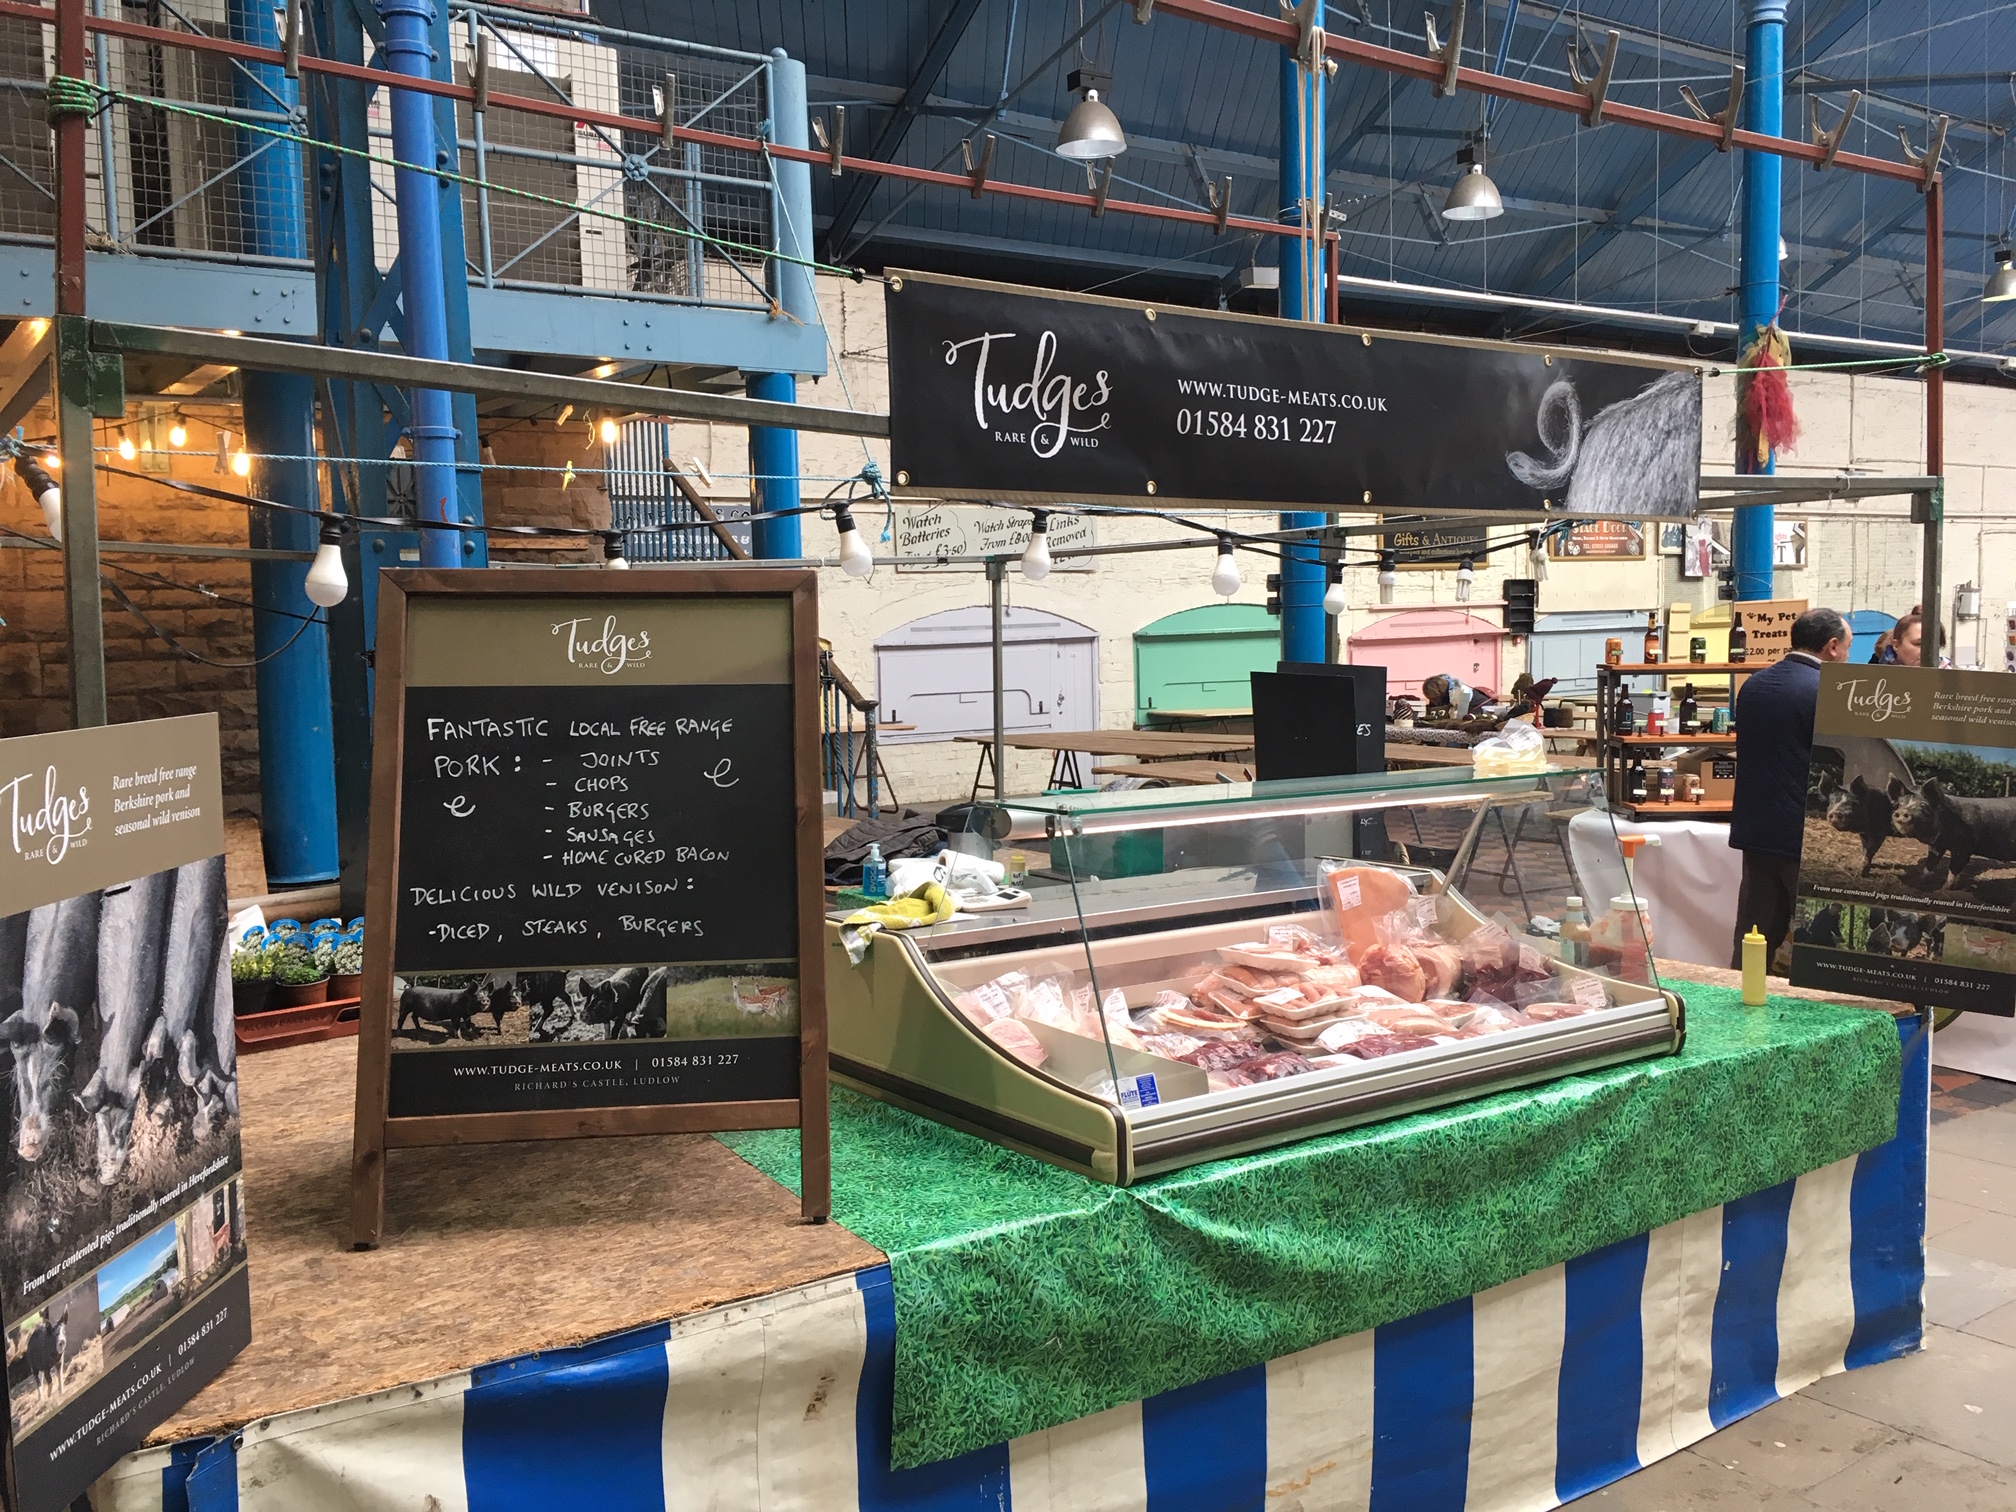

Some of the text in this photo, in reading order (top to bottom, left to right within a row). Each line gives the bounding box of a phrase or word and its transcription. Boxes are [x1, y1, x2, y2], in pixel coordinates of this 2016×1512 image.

[941, 330, 1114, 459] Tudges
[1177, 377, 1388, 413] WWW.TUDGE-MEATS.CO.UK
[1176, 407, 1338, 444] 01584 831 227
[994, 430, 1099, 449] RARE & WILD
[902, 513, 942, 530] Watch
[973, 519, 1004, 534] Watch
[1049, 515, 1080, 532] Links
[899, 527, 951, 547] Batteries
[979, 537, 1007, 551] From
[1393, 532, 1419, 547] Gifts
[1421, 535, 1430, 545] &
[1757, 612, 1797, 626] My Pet
[551, 615, 653, 675] Tudges
[1752, 629, 1788, 639] Treats
[1767, 647, 1781, 657] per
[626, 661, 646, 669] WILD
[1836, 678, 1912, 722] Tudges
[1932, 702, 2012, 715] Berkshire pork and
[1933, 691, 2016, 706] Rare breed free rang
[427, 716, 733, 741] FANTASTIC LOCAL FREE RANGE
[1930, 714, 2016, 726] seasonal wild veniso
[580, 749, 660, 769] JOINTS
[112, 764, 197, 790] Rare breed free range
[574, 775, 629, 792] CHOPS
[113, 784, 190, 813] Berkshire pork and
[0, 765, 93, 865] Tudges
[114, 805, 200, 836] seasonal wild venison
[567, 801, 650, 824] BURGERS
[566, 827, 656, 848] SAUSAGES
[24, 838, 88, 861] RARE & WILD
[562, 849, 609, 866] HOME
[614, 849, 666, 866] CURED
[675, 846, 730, 862] BACON
[410, 883, 517, 906] DELICIOUS
[532, 883, 582, 898] WILD
[1813, 884, 1831, 892] From
[1843, 889, 1876, 897] contented
[1875, 892, 1889, 900] pigs
[1890, 894, 1933, 906] traditionally
[1933, 899, 1955, 907] reared
[1964, 902, 2011, 914] Herefordshire
[618, 914, 704, 938] BURGERS
[1816, 961, 1917, 981] WWW.TUDGE-MEATS.CO.UK
[1934, 977, 1958, 987] 01584
[1959, 980, 1974, 989] 831
[1975, 983, 1991, 991] 227
[453, 1060, 622, 1077] WWW.TUDGE-MEATS.CO.UK
[651, 1057, 688, 1068] 01584
[692, 1055, 713, 1066] 831
[717, 1054, 739, 1065] 227
[514, 1079, 578, 1091] RICHARD'S
[633, 1075, 681, 1086] LUDLOW
[23, 1155, 229, 1296] From our contented pigs traditionally reared in Herefordshire
[49, 1362, 162, 1462] WWW.TUDGE-MEATS.CO.UK
[178, 1331, 200, 1356] 01584
[201, 1323, 214, 1338] 831
[215, 1307, 228, 1326] 227
[96, 1407, 137, 1446] RICHARD'S
[167, 1356, 195, 1385] LUDLOW
